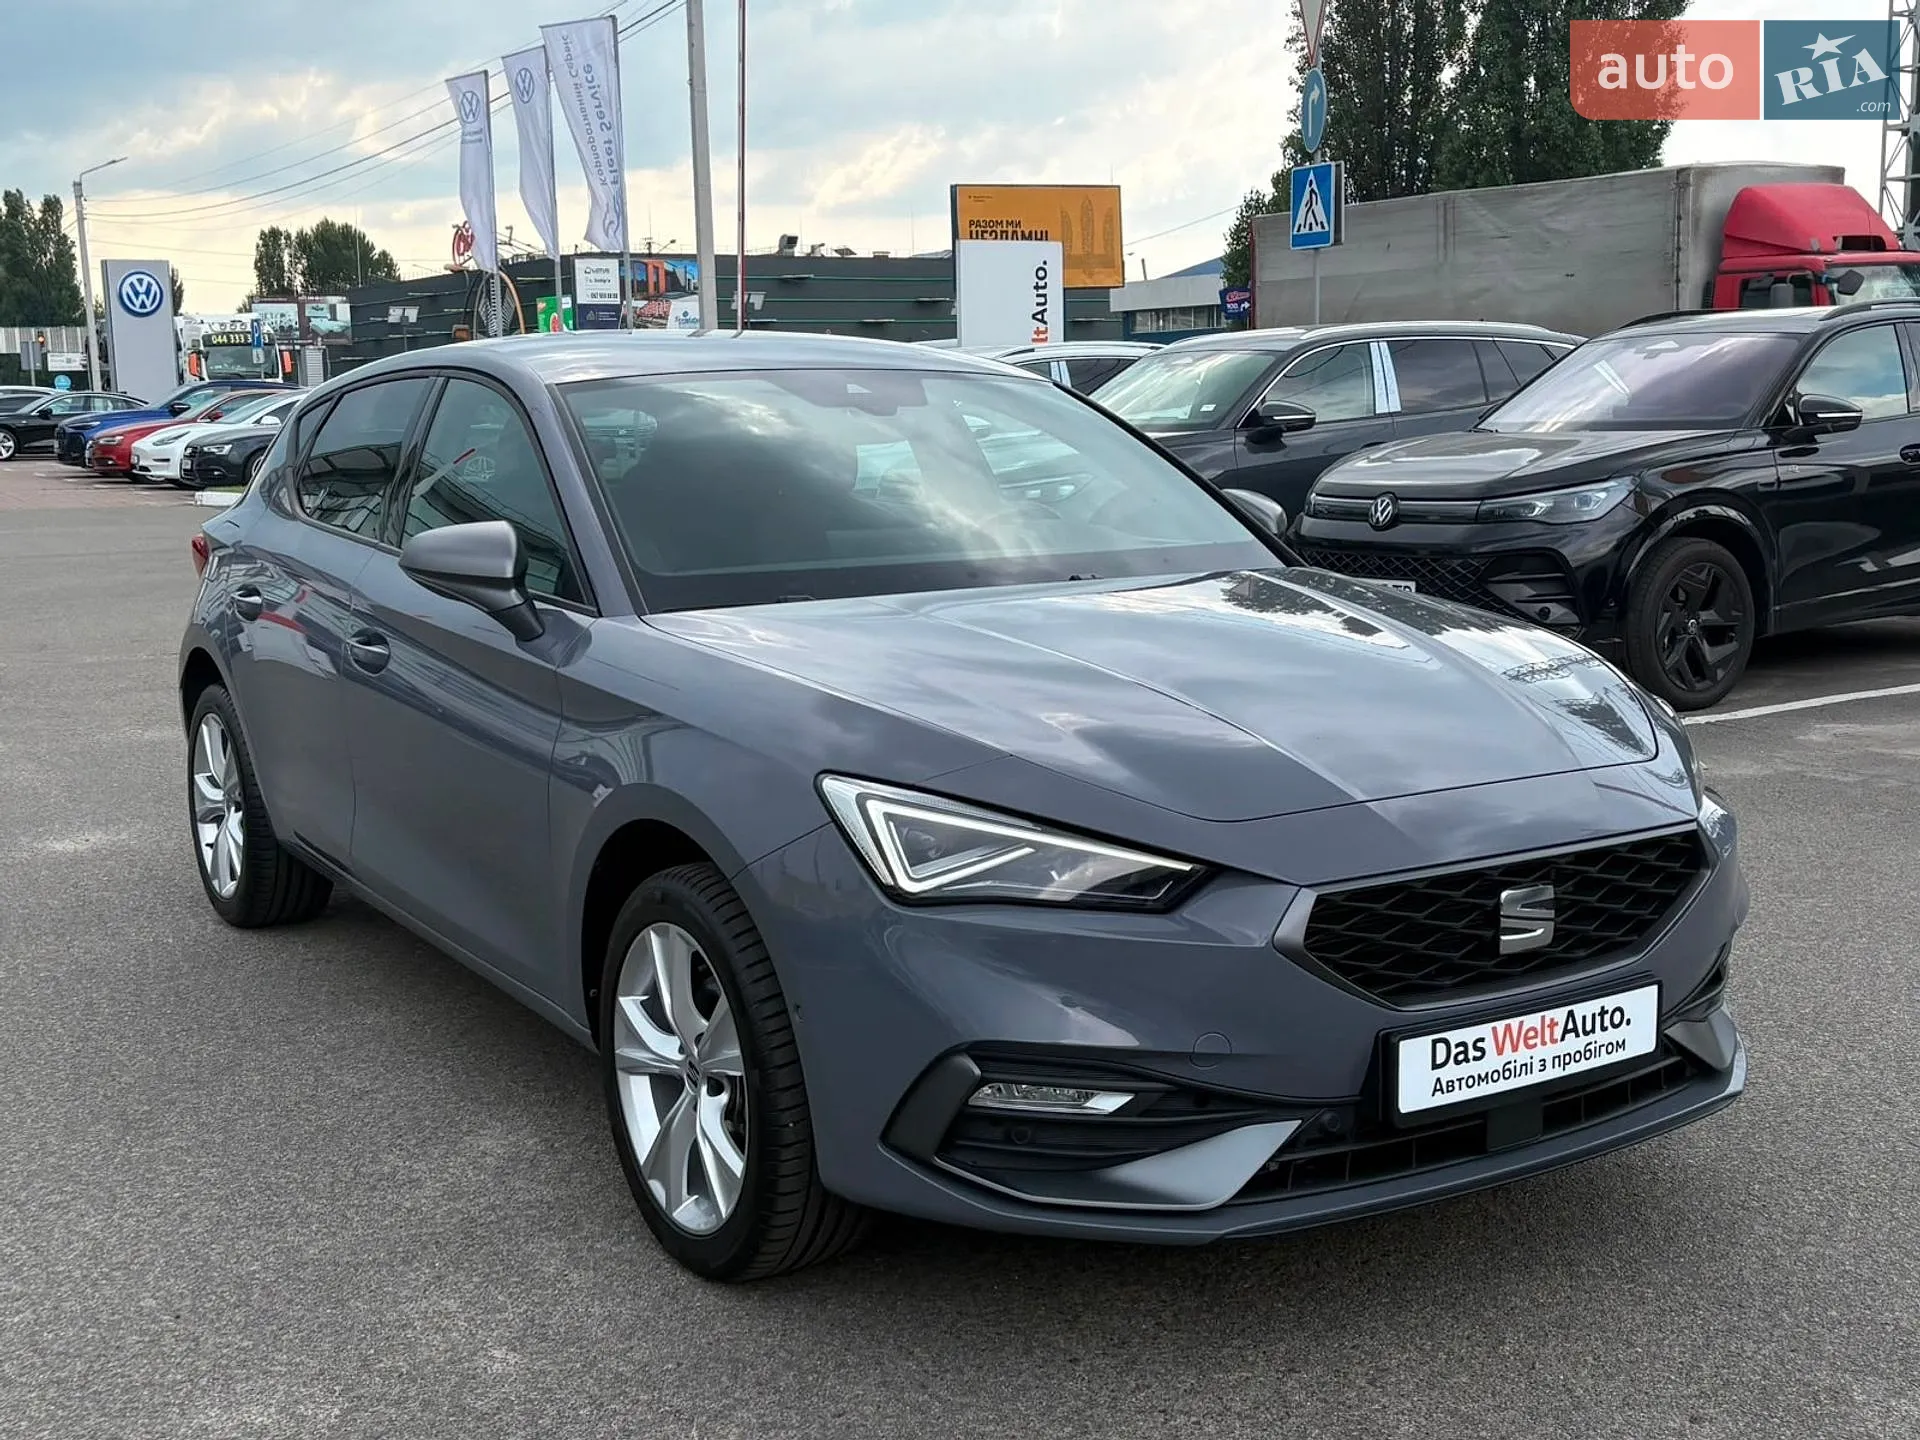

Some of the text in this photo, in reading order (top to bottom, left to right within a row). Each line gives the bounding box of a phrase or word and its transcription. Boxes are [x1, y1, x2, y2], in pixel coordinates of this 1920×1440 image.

[968, 219, 1021, 229] РАЗОМ МИ
[1430, 1036, 1486, 1071] Das
[1431, 1038, 1626, 1097] Автомобілі з пробігом
